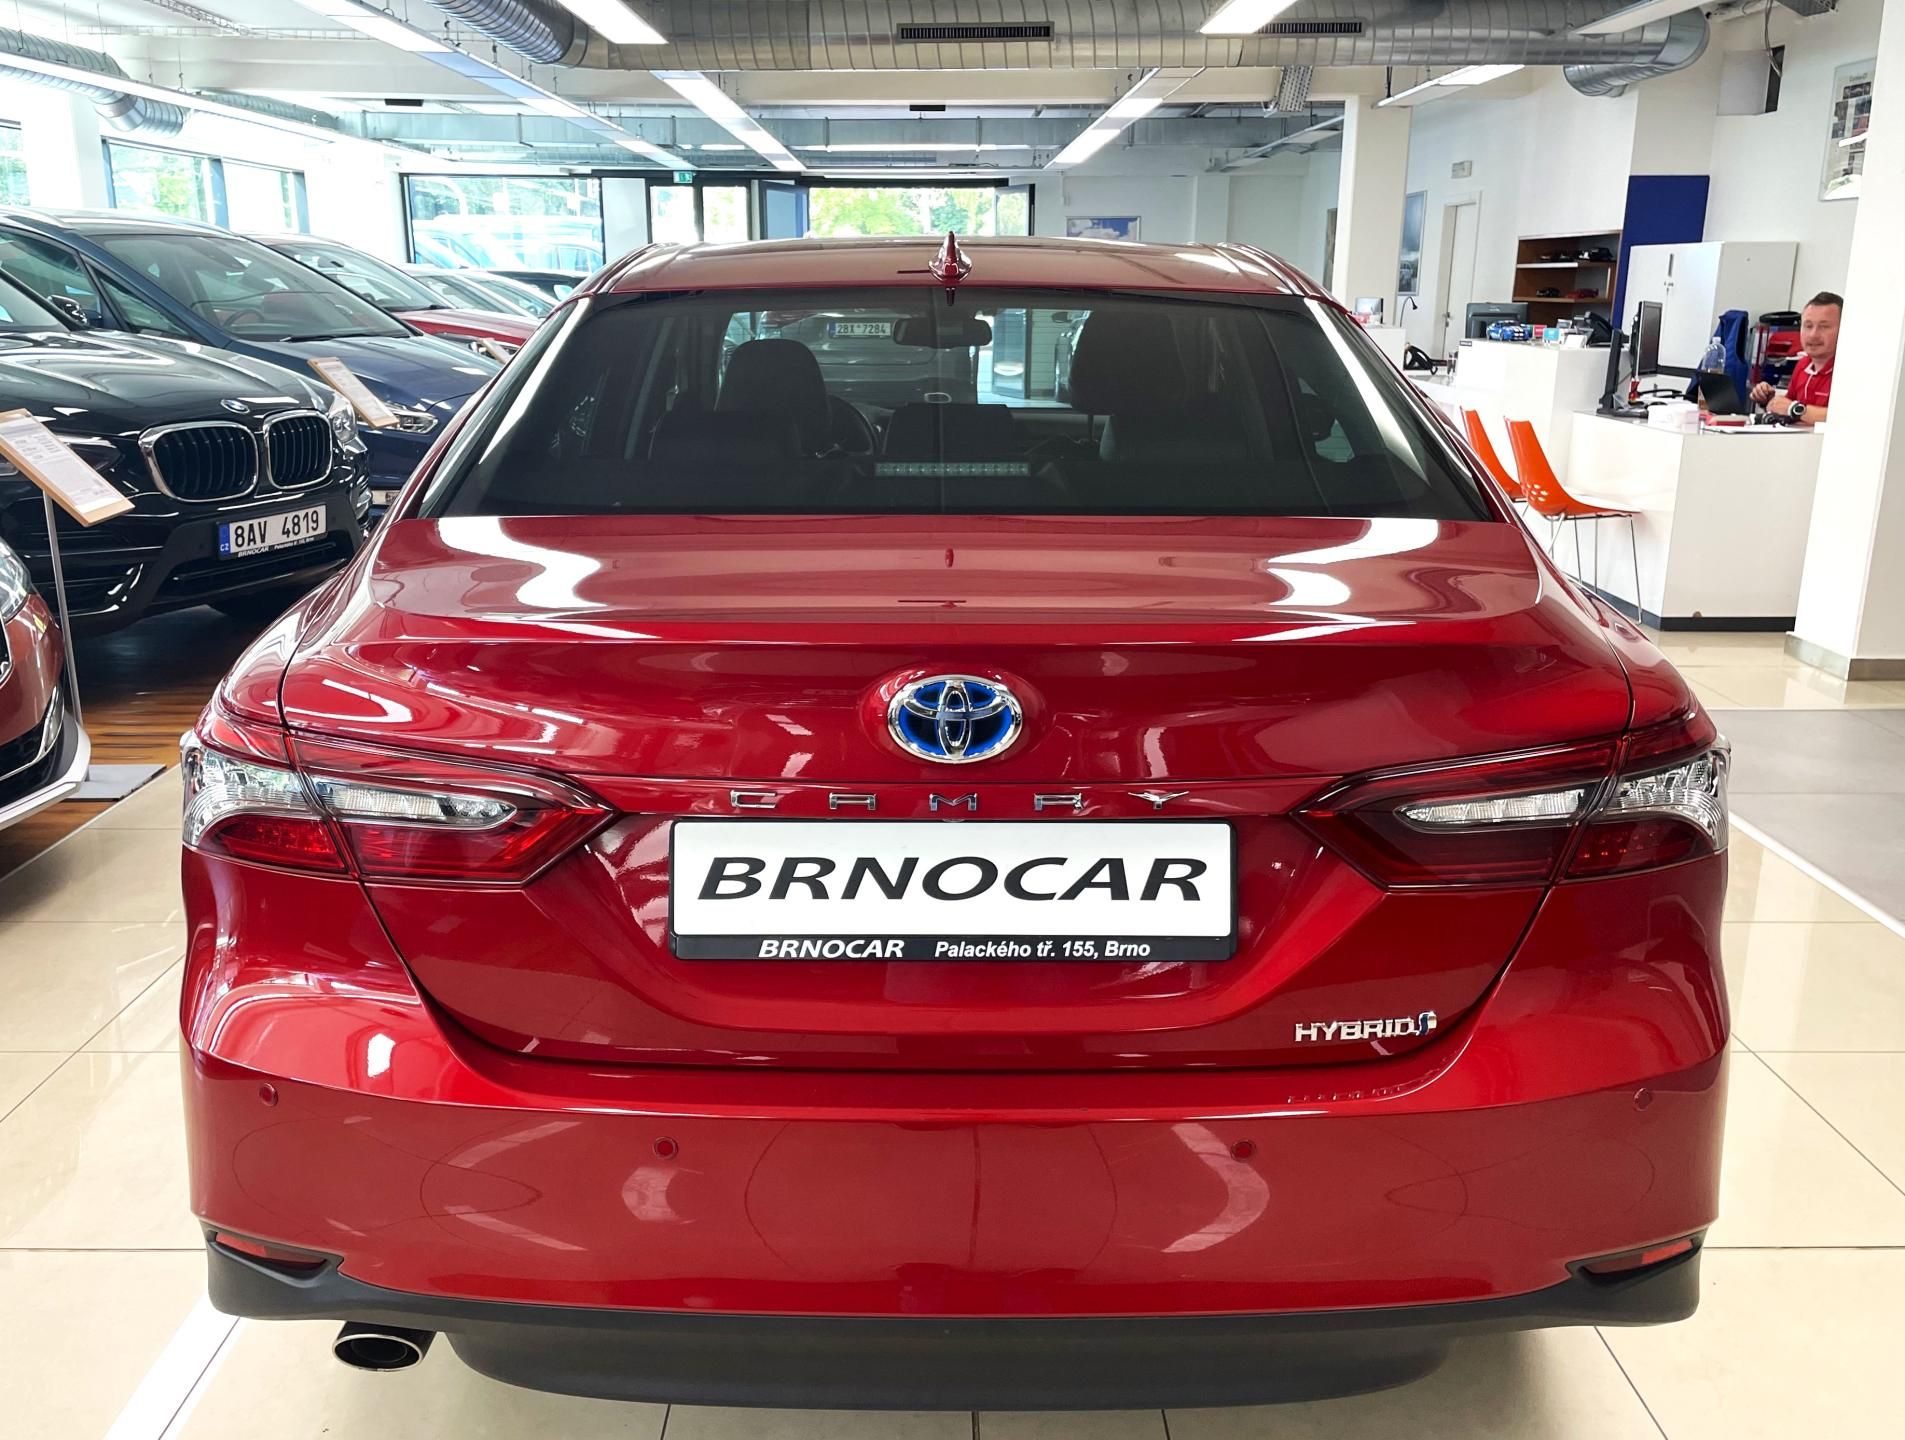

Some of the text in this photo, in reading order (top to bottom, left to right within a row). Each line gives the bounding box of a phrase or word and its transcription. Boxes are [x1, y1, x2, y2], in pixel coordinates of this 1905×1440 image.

[234, 521, 267, 548] 8AV
[281, 510, 319, 538] 4819
[220, 543, 230, 552] CZ
[730, 790, 1190, 811] CAMRY
[697, 856, 1208, 901] BRNOCAR
[758, 939, 1151, 959] BRNOCAR Palackého tř. 155, Brno
[1295, 1017, 1416, 1041] HYBRID
